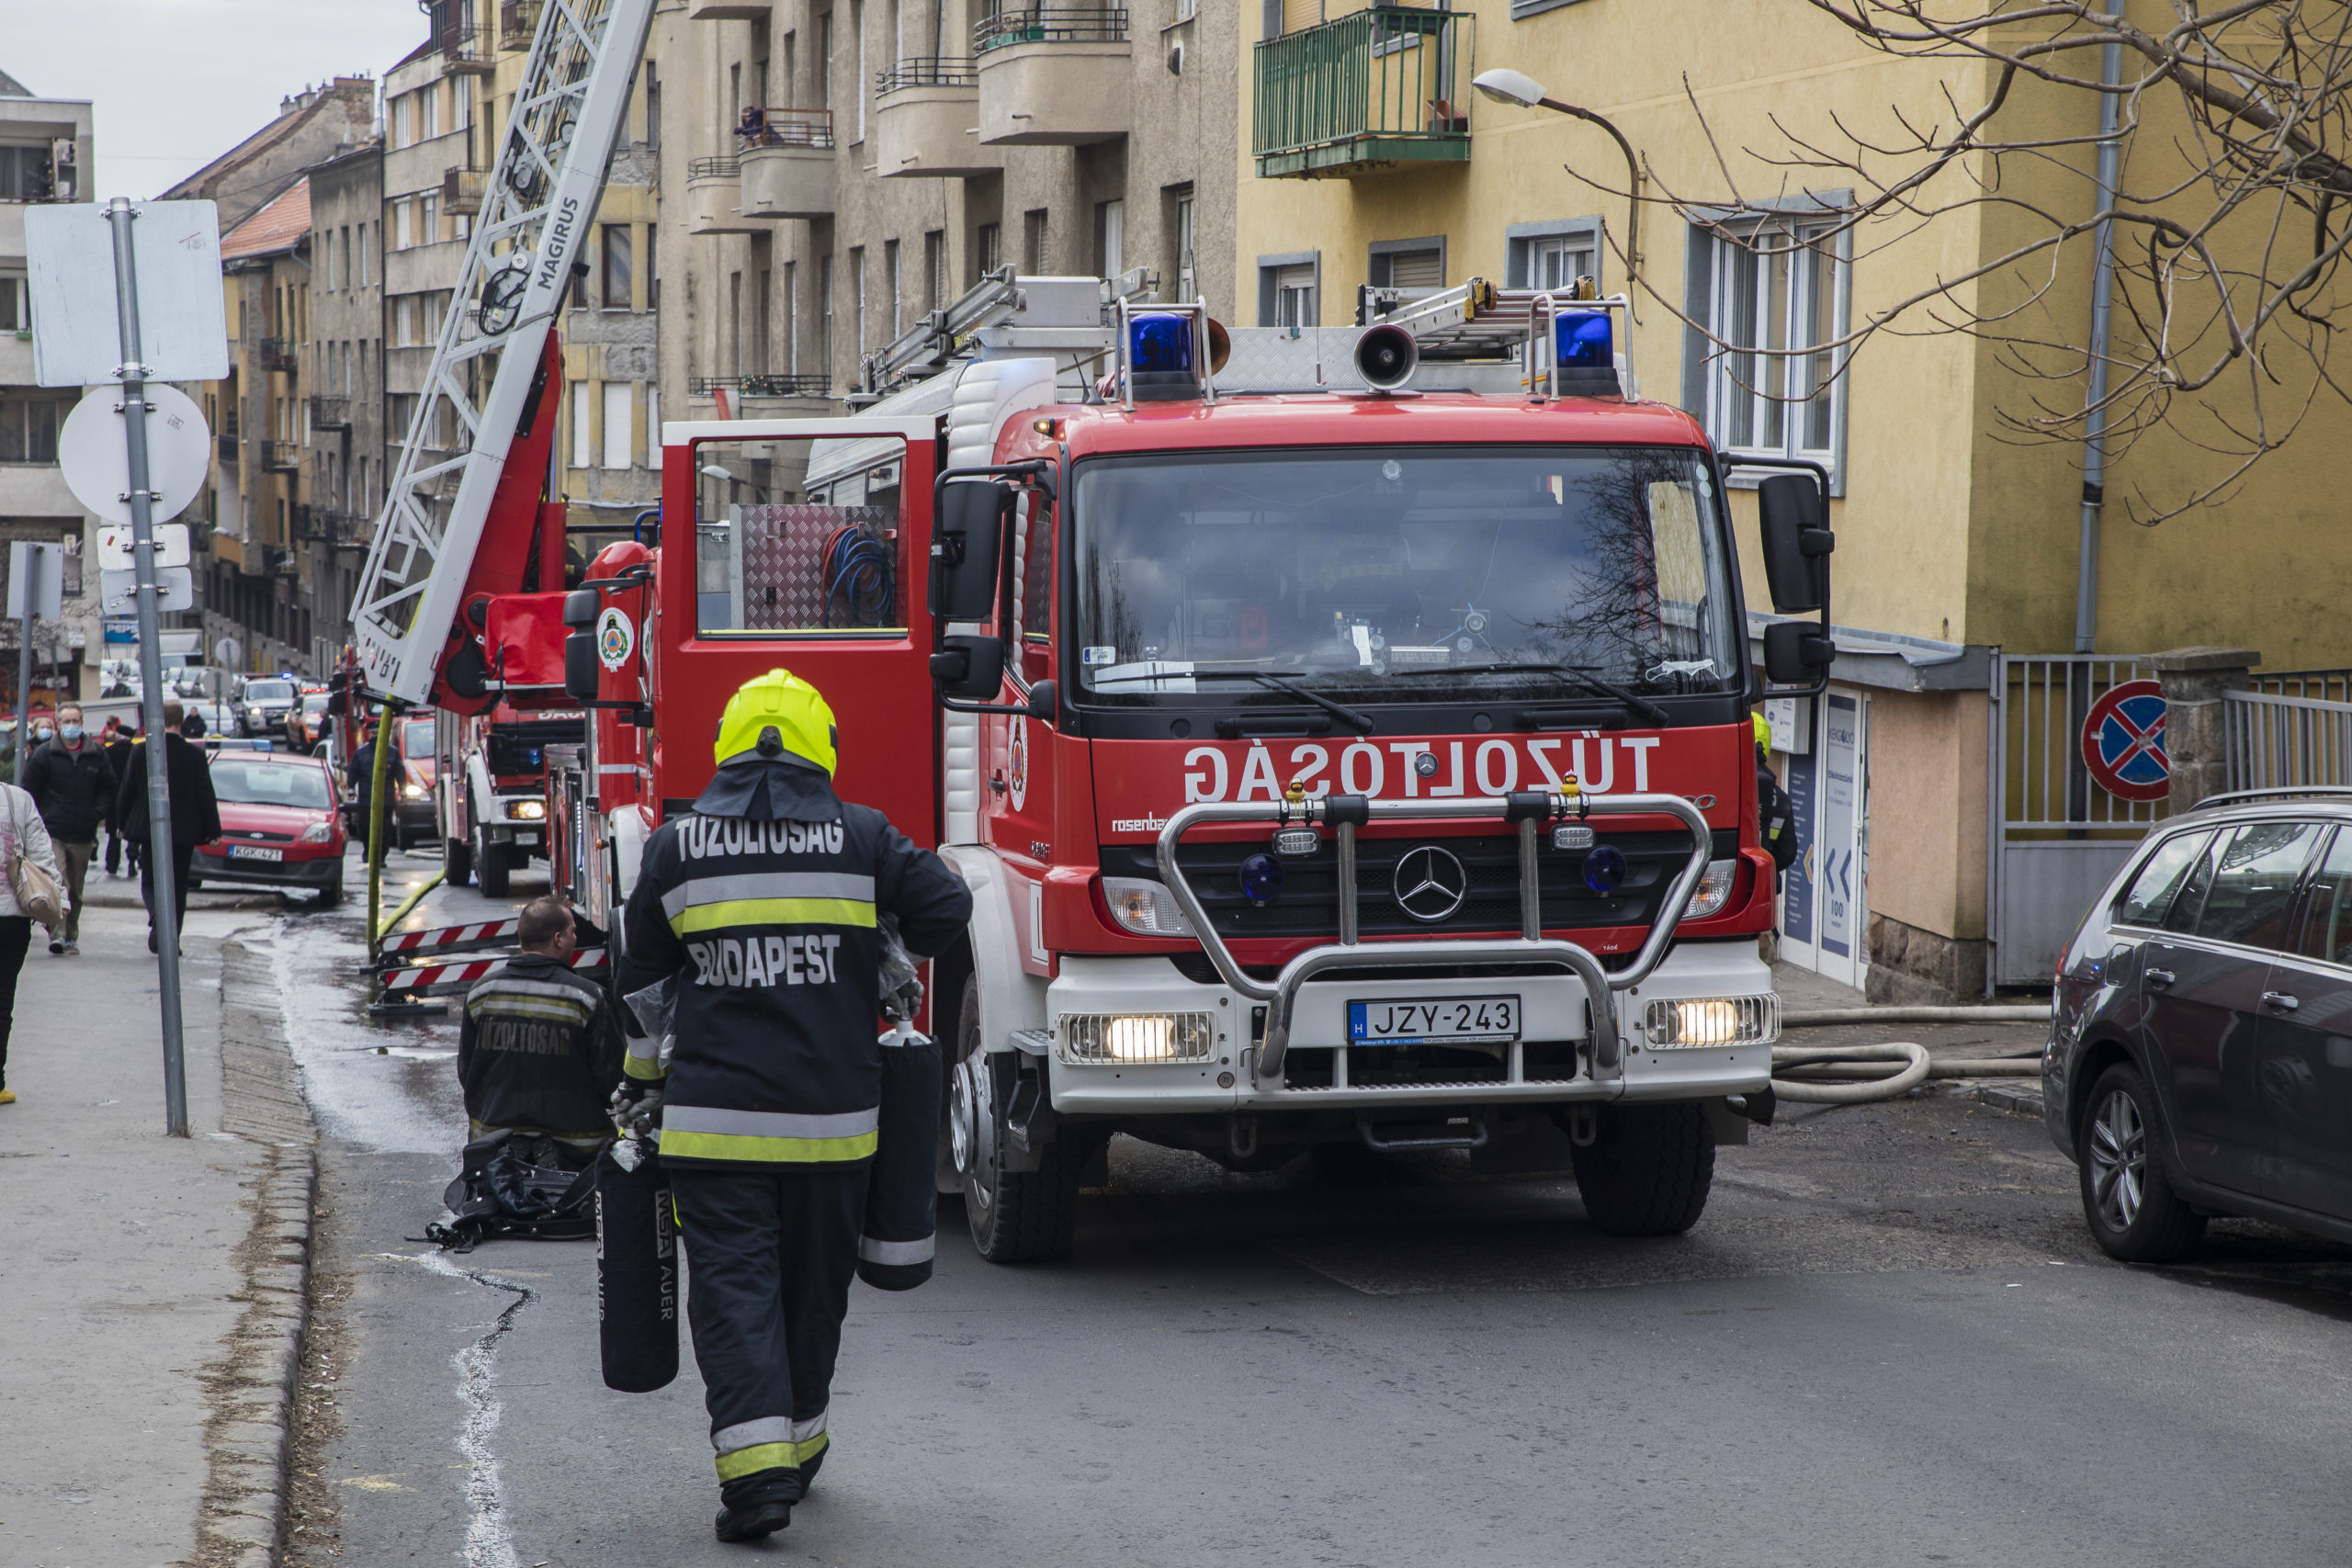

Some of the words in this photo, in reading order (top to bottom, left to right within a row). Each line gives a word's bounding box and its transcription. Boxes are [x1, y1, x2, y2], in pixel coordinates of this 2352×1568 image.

[537, 197, 578, 289] MAGIRUS
[1112, 811, 1169, 832] rosenba
[235, 846, 279, 860] KGK-421
[687, 934, 841, 988] BUDAPEST
[1354, 1023, 1363, 1034] H
[1374, 1002, 1511, 1034] JZY-243
[657, 1193, 672, 1254] MSA
[661, 1266, 673, 1321] AUER
